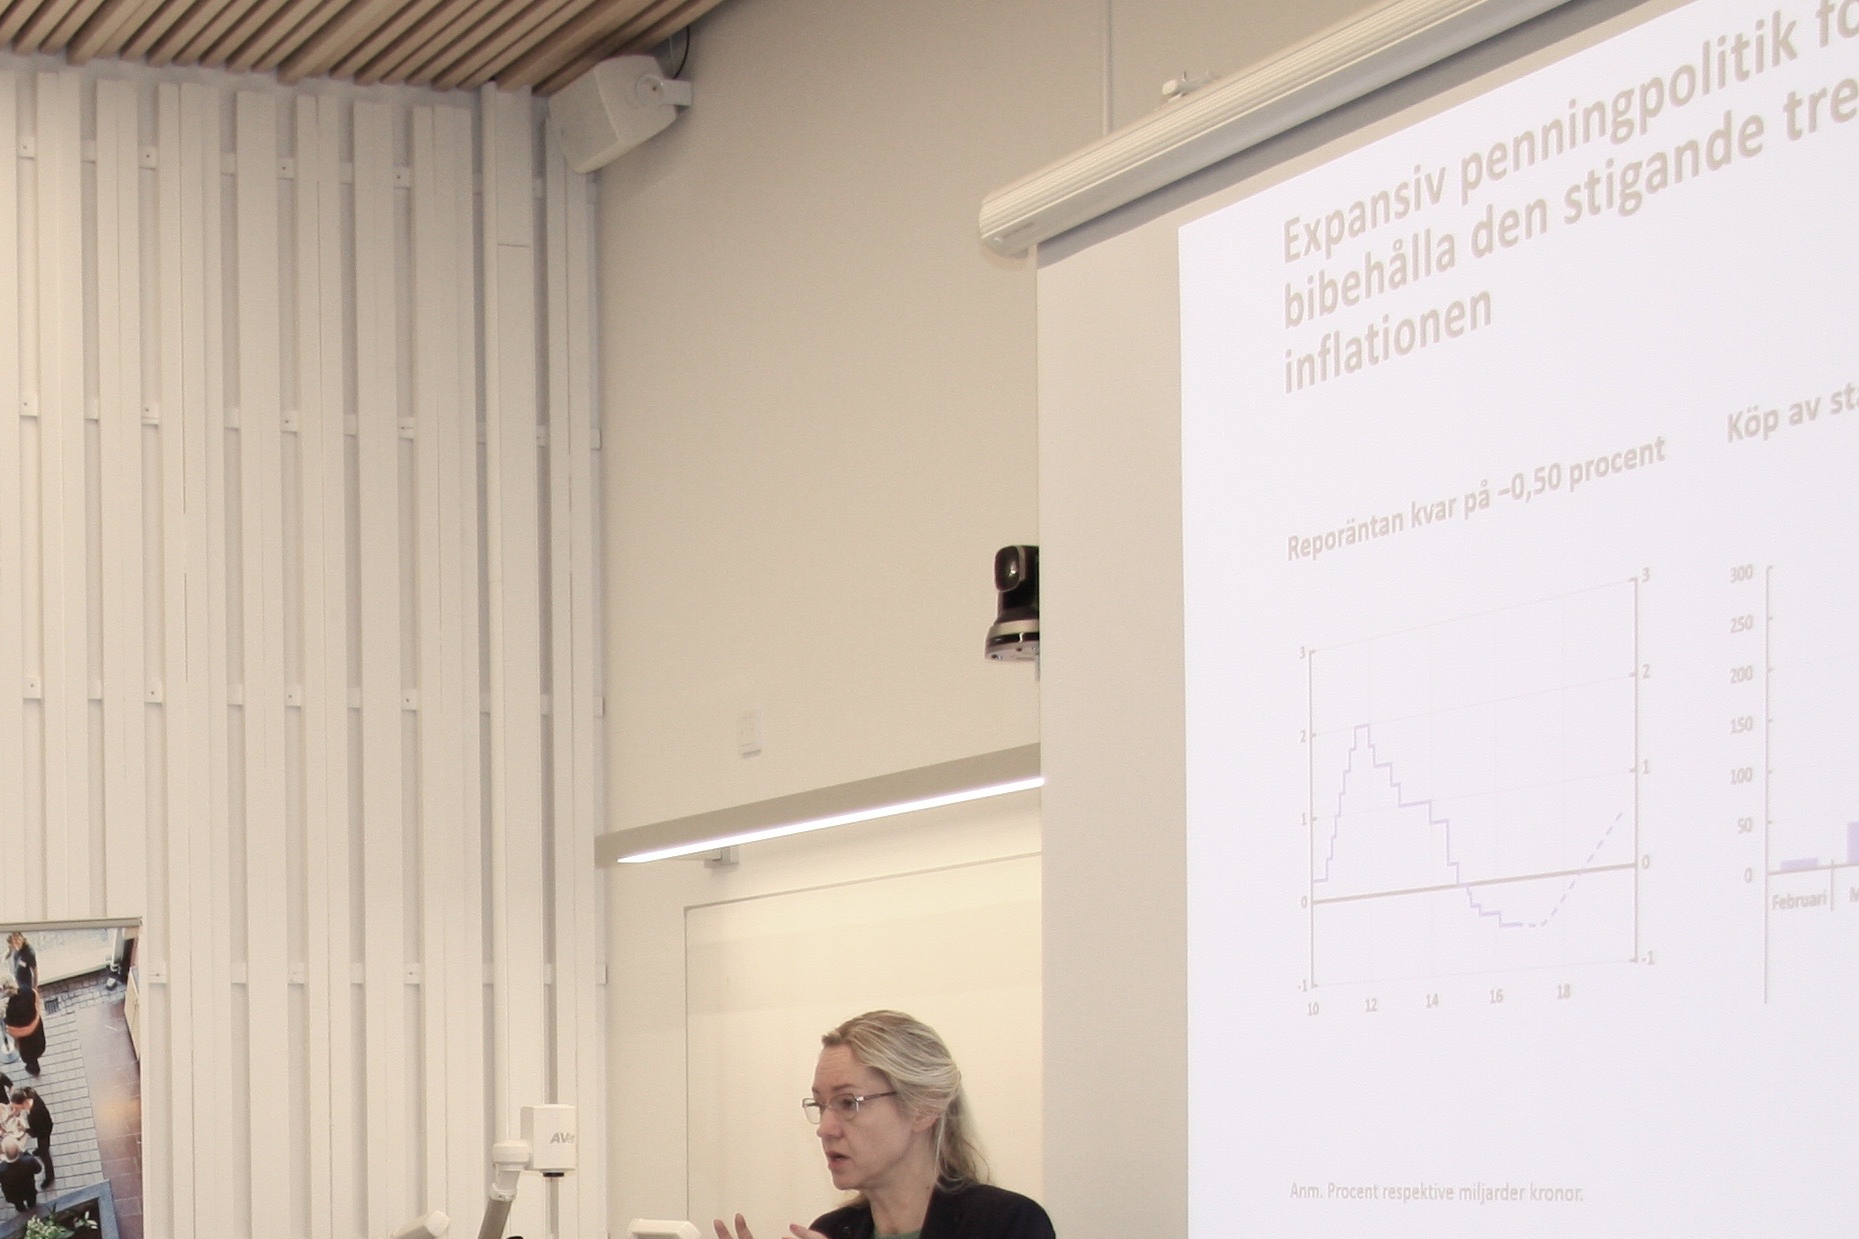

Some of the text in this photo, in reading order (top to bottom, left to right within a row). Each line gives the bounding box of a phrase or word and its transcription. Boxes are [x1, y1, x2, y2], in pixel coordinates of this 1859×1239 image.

[1283, 164, 1446, 263] Expansiv
[1460, 10, 1797, 207] penningpolitik
[1284, 77, 1859, 329] bibehålla den stigande tre
[1284, 290, 1492, 394] inflationen
[1727, 381, 1859, 443] Köp av st
[1287, 510, 1404, 561] Reporäntan
[1410, 497, 1457, 528] kvar
[1464, 478, 1490, 520] på
[1569, 435, 1666, 493] procent
[1641, 567, 1651, 583] 3
[1729, 563, 1754, 584] 300
[1729, 614, 1754, 635] 250
[1641, 663, 1651, 680] 2
[1729, 665, 1754, 684] 200
[1729, 715, 1753, 734] 150
[1729, 766, 1753, 785] 100
[1737, 816, 1753, 834] 50
[1641, 854, 1651, 870] 0
[1744, 867, 1753, 884] 0
[1772, 889, 1827, 910] Februari
[1306, 983, 1571, 1017] 10 12 14 16 18
[1290, 1181, 1584, 1205] Anm. Procent respektive miljarder kronor.
